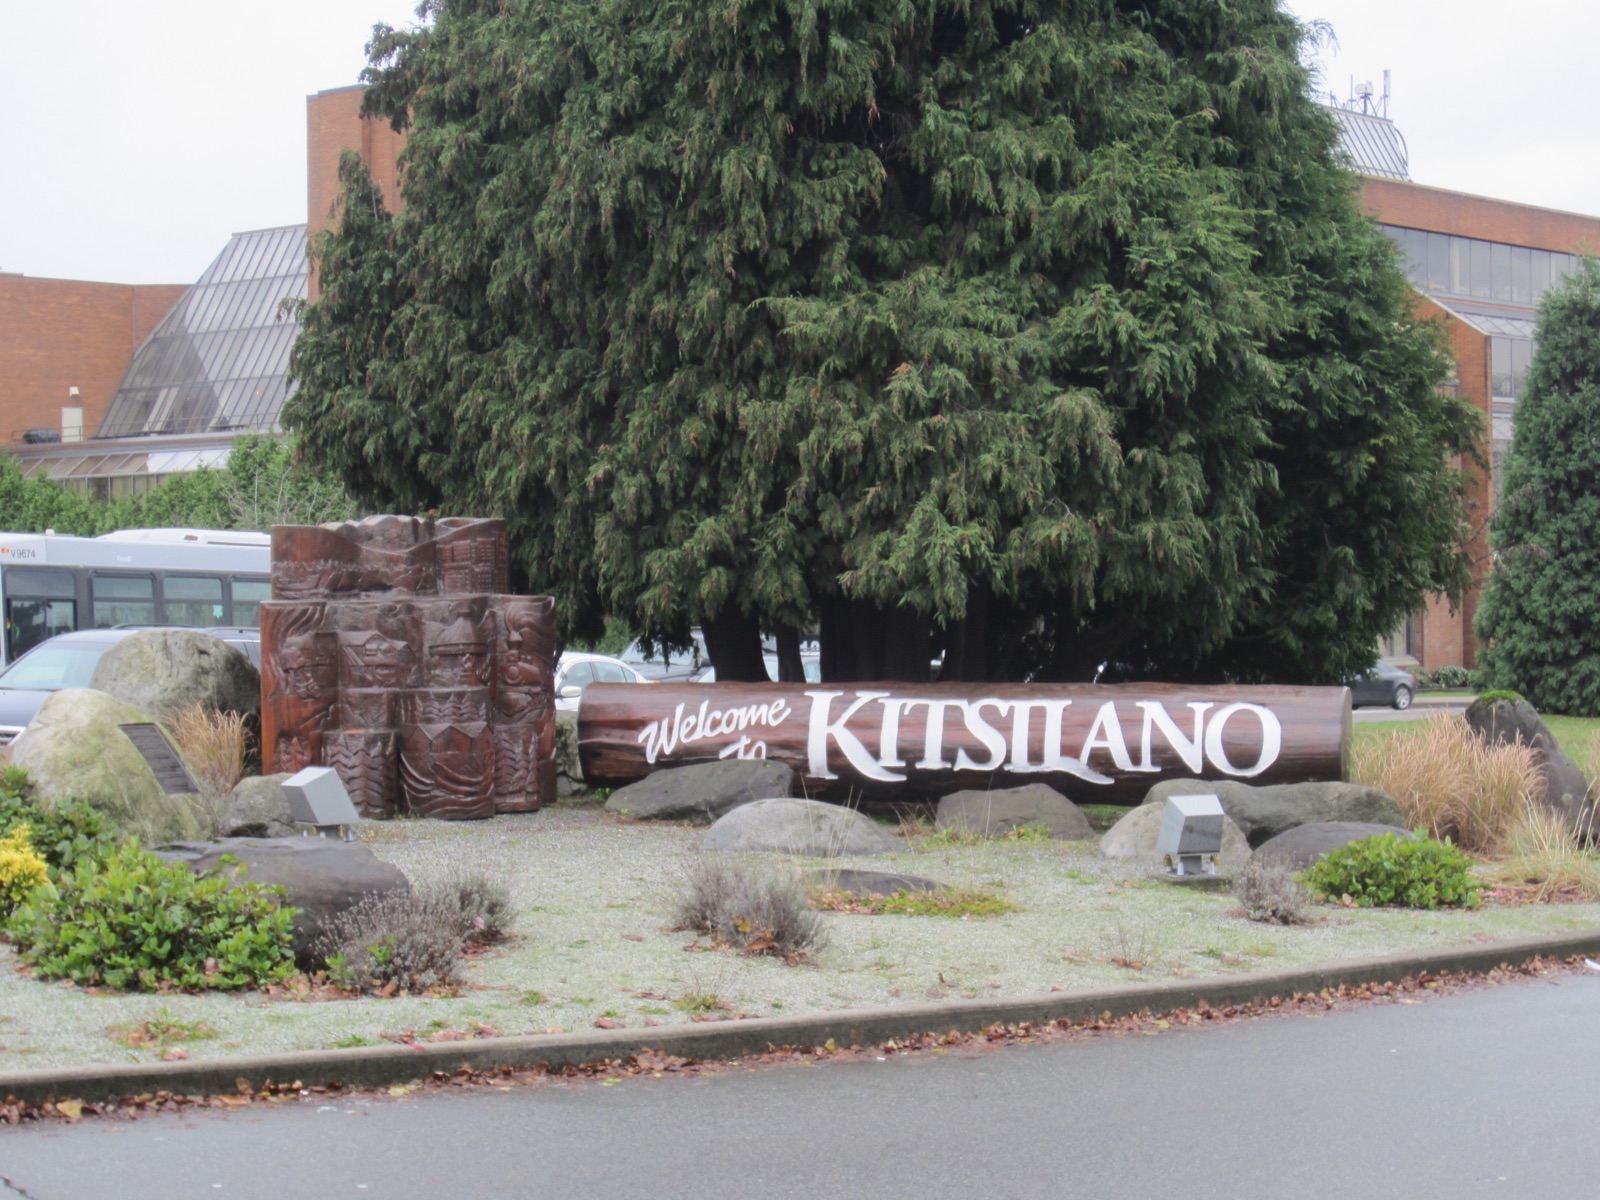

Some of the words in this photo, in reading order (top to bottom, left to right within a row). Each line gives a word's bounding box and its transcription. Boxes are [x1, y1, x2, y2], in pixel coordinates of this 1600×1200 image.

[10, 549, 36, 558] V9674
[638, 699, 791, 763] Welcome
[804, 691, 1282, 784] KITSILANO
